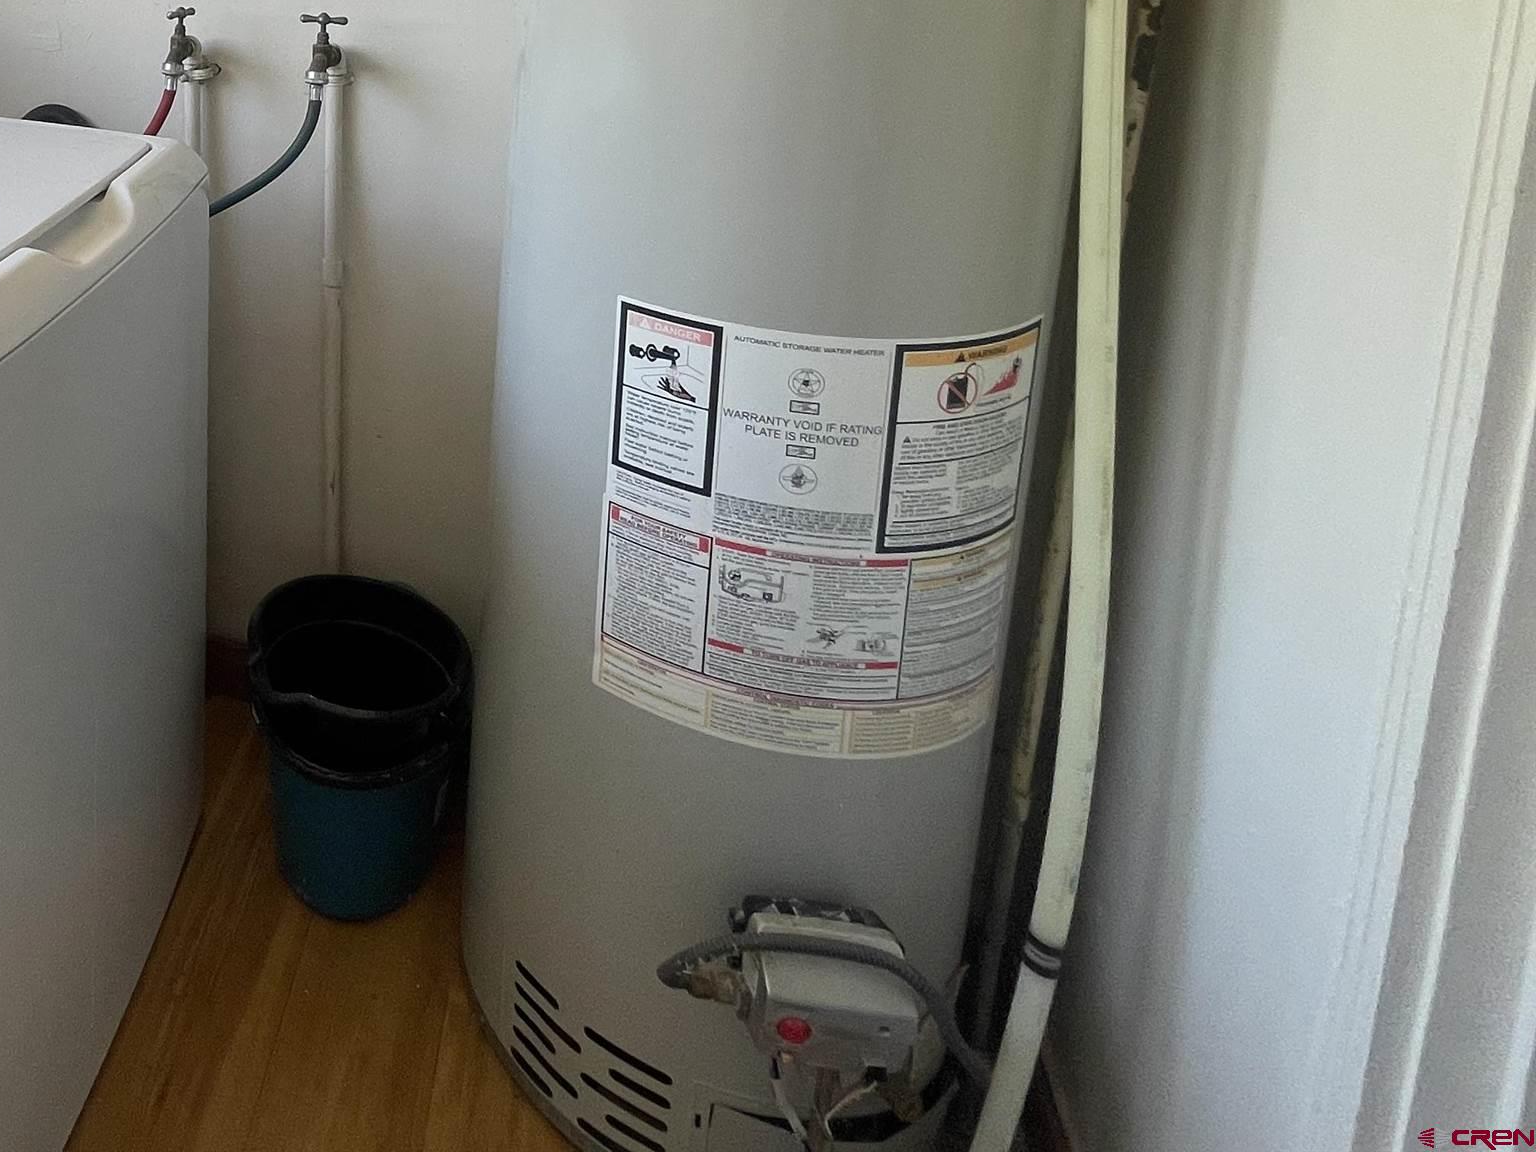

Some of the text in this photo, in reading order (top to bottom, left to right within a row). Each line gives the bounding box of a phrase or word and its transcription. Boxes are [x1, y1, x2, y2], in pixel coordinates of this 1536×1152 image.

[654, 323, 702, 343] DANGER
[734, 335, 781, 348] AUTOMATIC
[782, 342, 821, 353] STORAGE
[824, 347, 852, 355] WATER
[723, 408, 883, 435] WARRANTY VOID IF RATING
[745, 424, 859, 447] PLATE IS REMOVED
